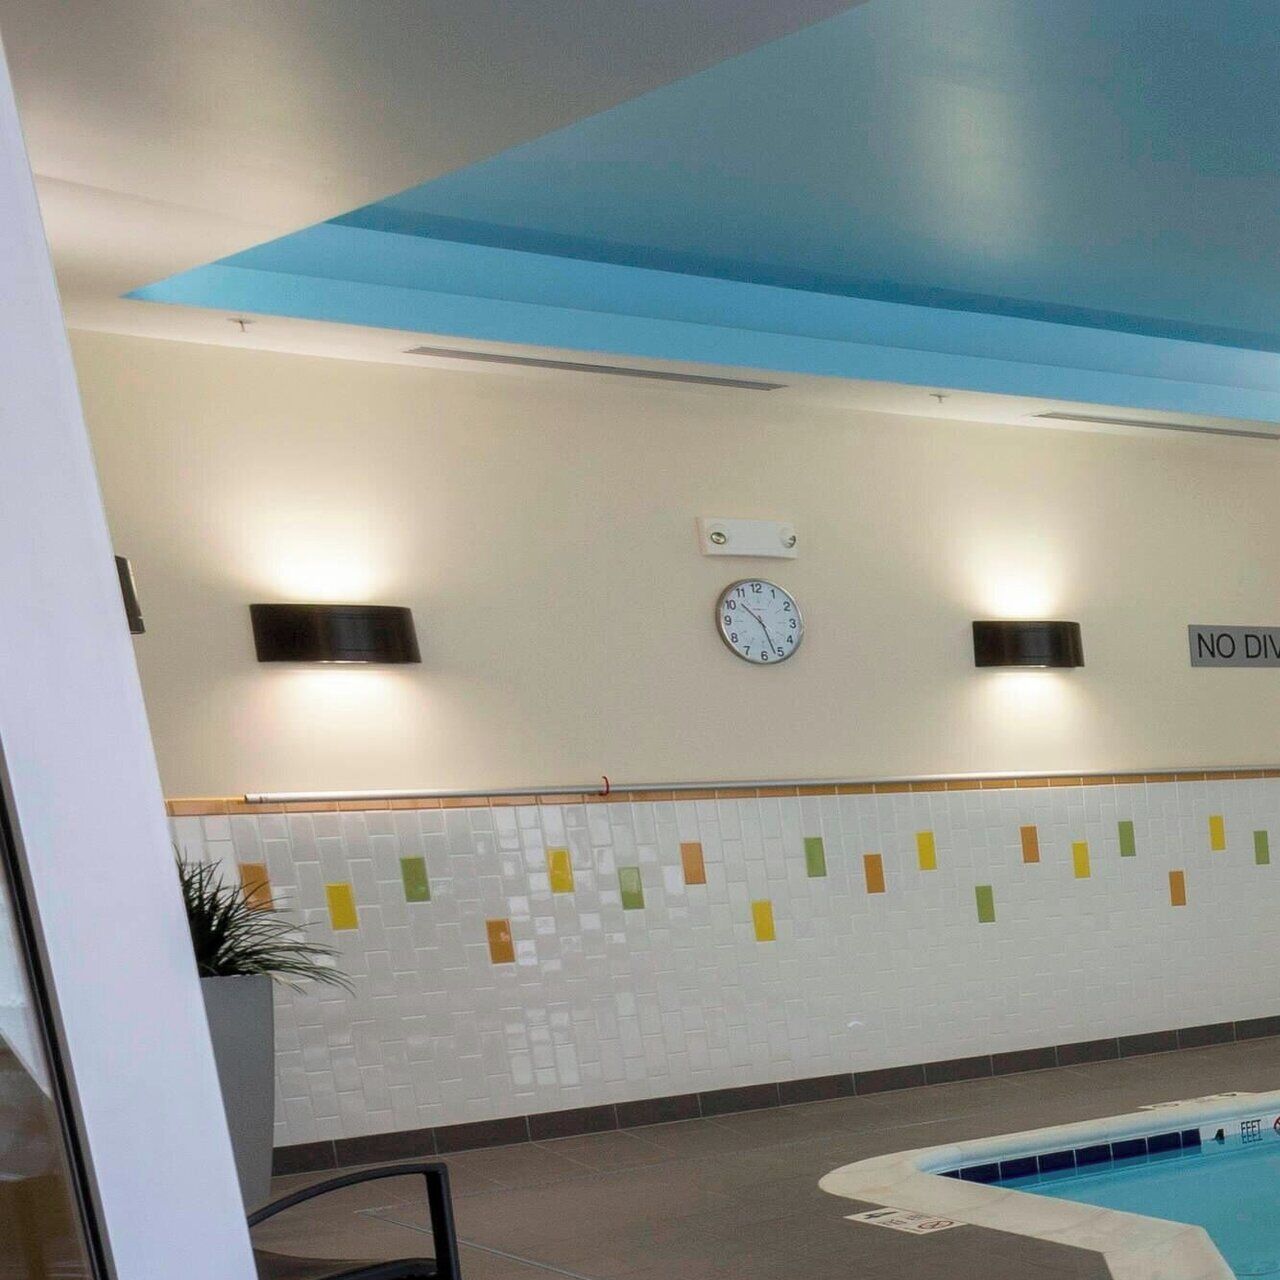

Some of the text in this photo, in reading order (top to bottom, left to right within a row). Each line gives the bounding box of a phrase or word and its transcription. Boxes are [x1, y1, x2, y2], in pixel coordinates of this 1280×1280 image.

[750, 583, 762, 593] 12
[736, 588, 745, 598] 11
[771, 590, 775, 598] 1
[726, 600, 736, 610] 10
[783, 602, 791, 611] 2
[724, 615, 732, 625] 9
[789, 619, 796, 628] 3
[731, 633, 738, 643] 8
[786, 635, 793, 644] 4
[1198, 633, 1235, 658] NO
[744, 646, 750, 655] 7
[777, 647, 784, 656] 5
[761, 651, 768, 660] 6
